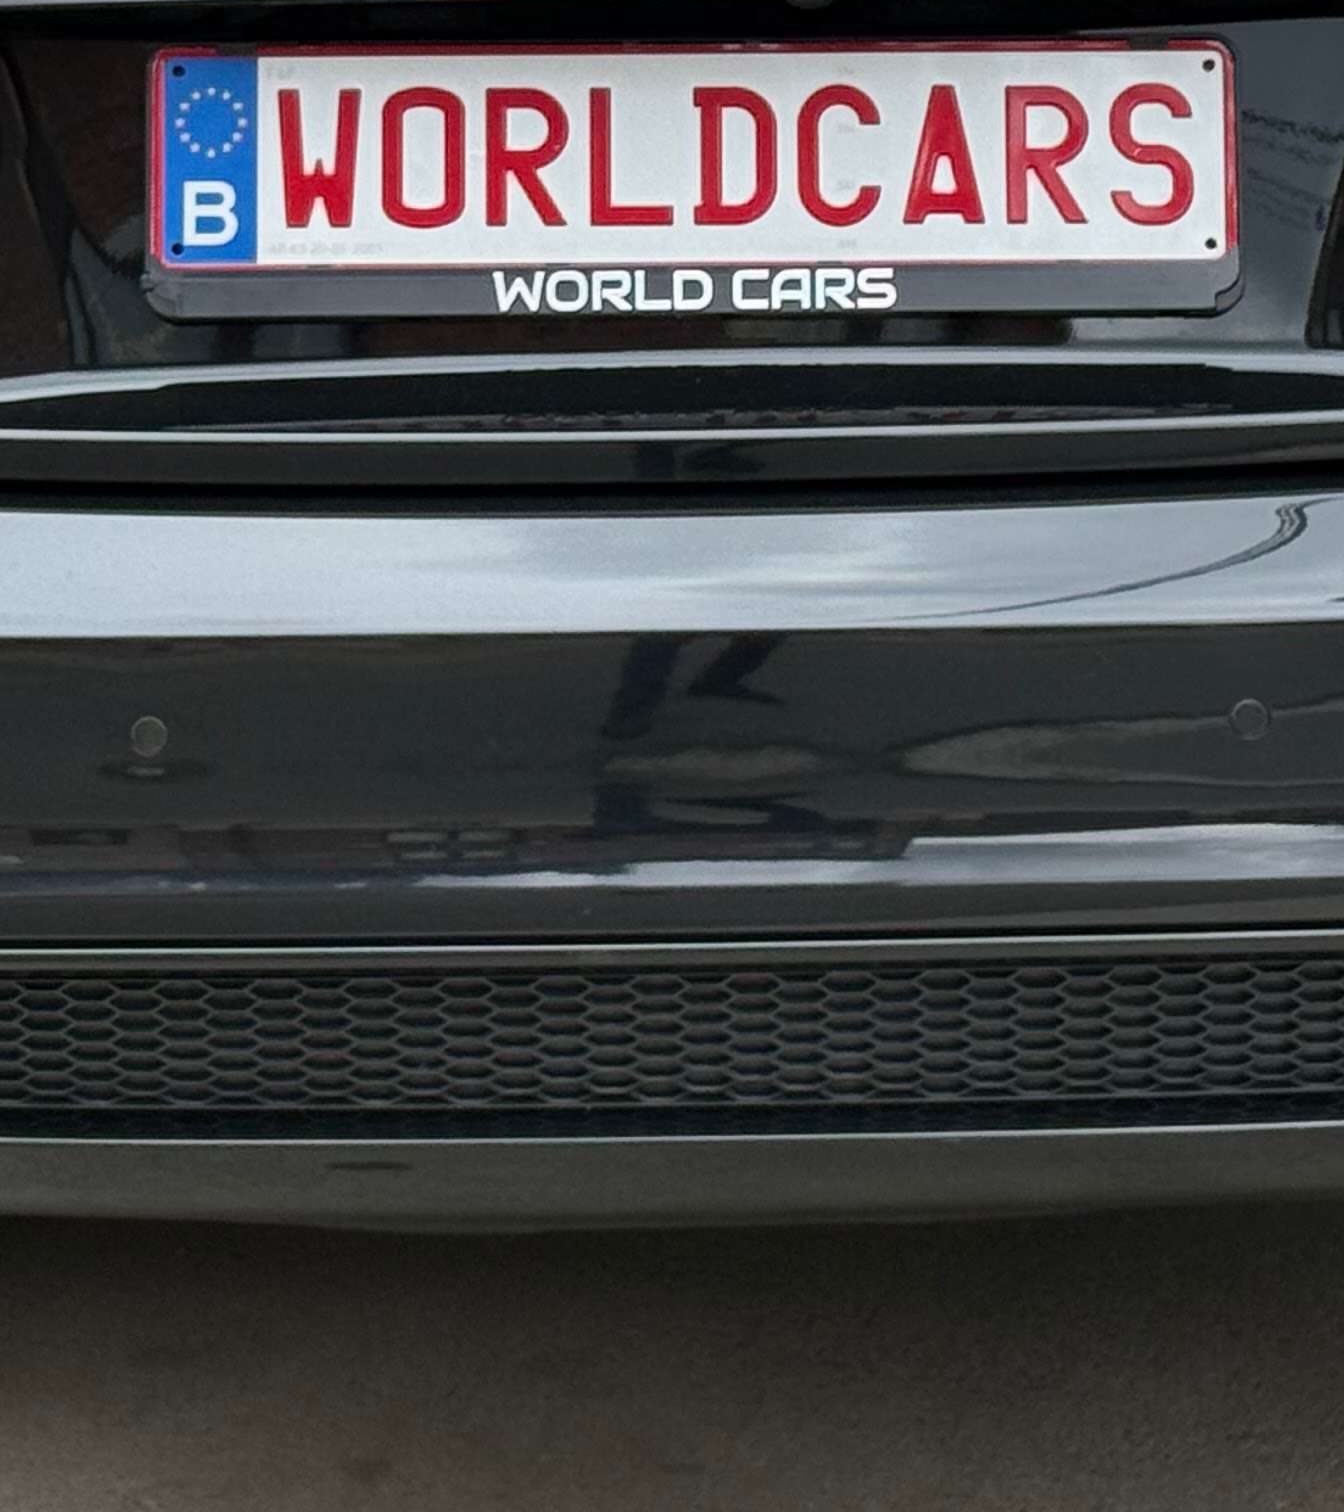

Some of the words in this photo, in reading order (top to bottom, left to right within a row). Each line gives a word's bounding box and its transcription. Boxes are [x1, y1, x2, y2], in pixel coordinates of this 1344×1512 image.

[277, 83, 1194, 229] WORLDCARS
[183, 180, 239, 246] B
[492, 269, 713, 312] WORLD
[731, 267, 898, 310] CARS
